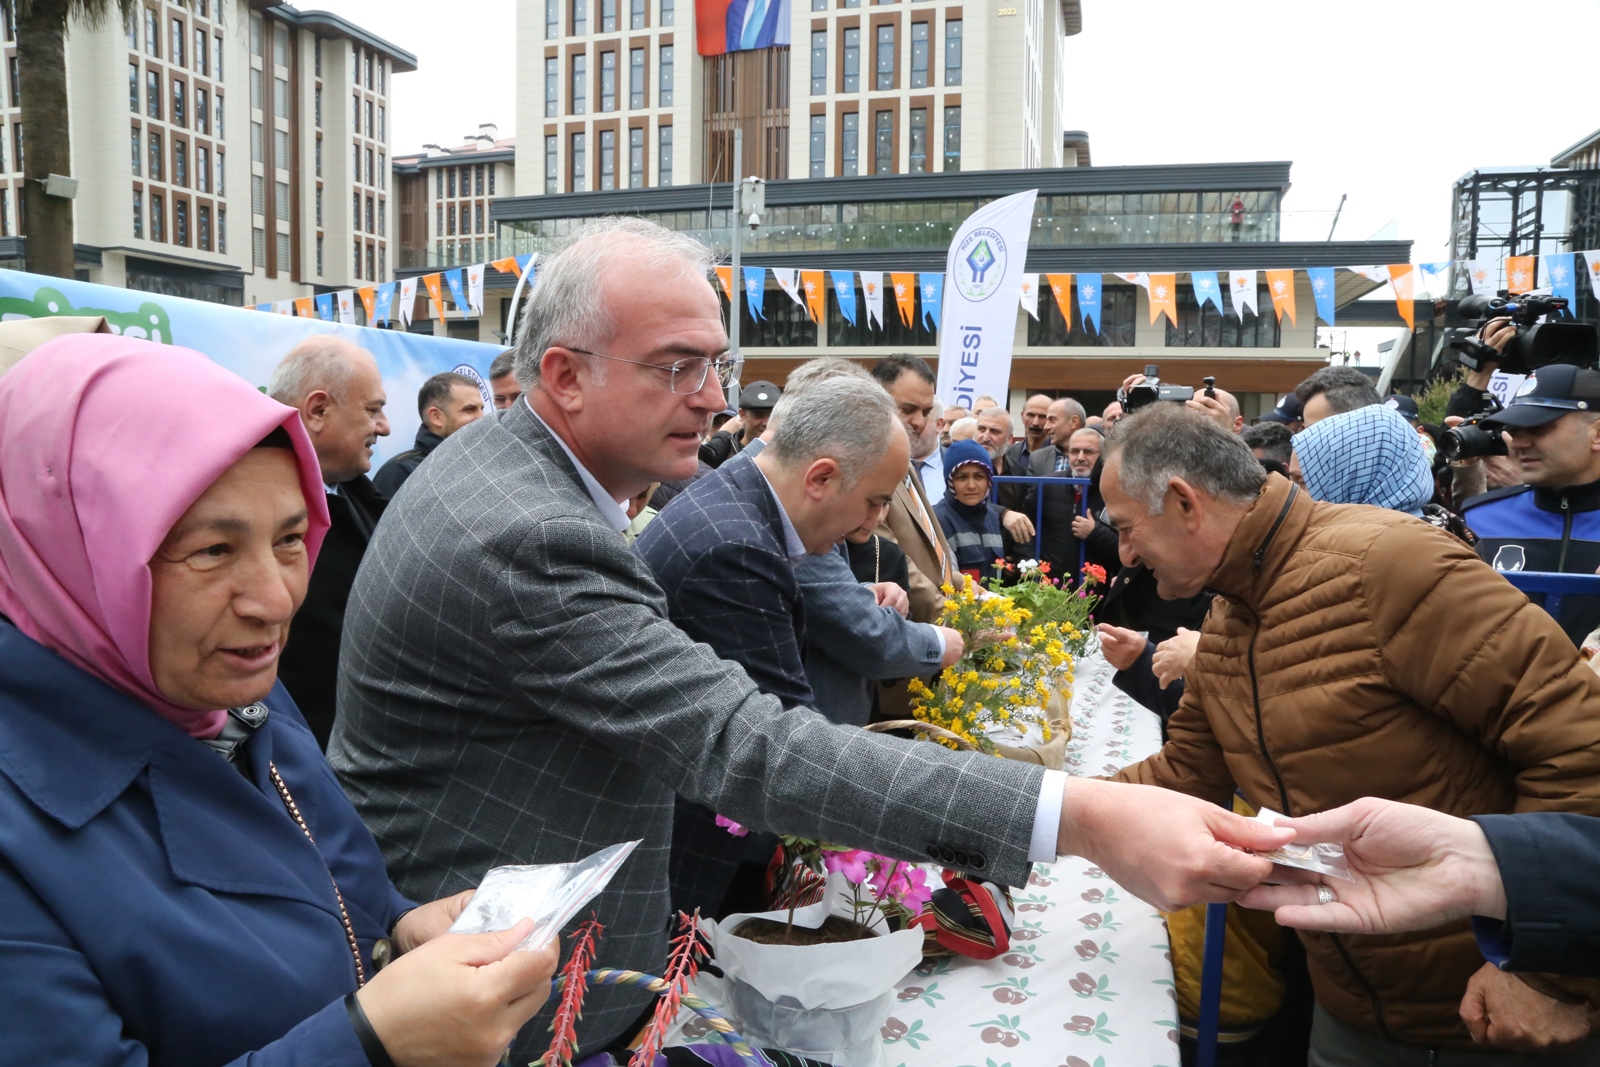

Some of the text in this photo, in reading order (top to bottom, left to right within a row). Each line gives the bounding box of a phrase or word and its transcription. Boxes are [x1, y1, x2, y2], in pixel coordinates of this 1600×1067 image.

[998, 8, 1016, 16] 2023
[961, 230, 1005, 252] RİZE BELEDİYESİ
